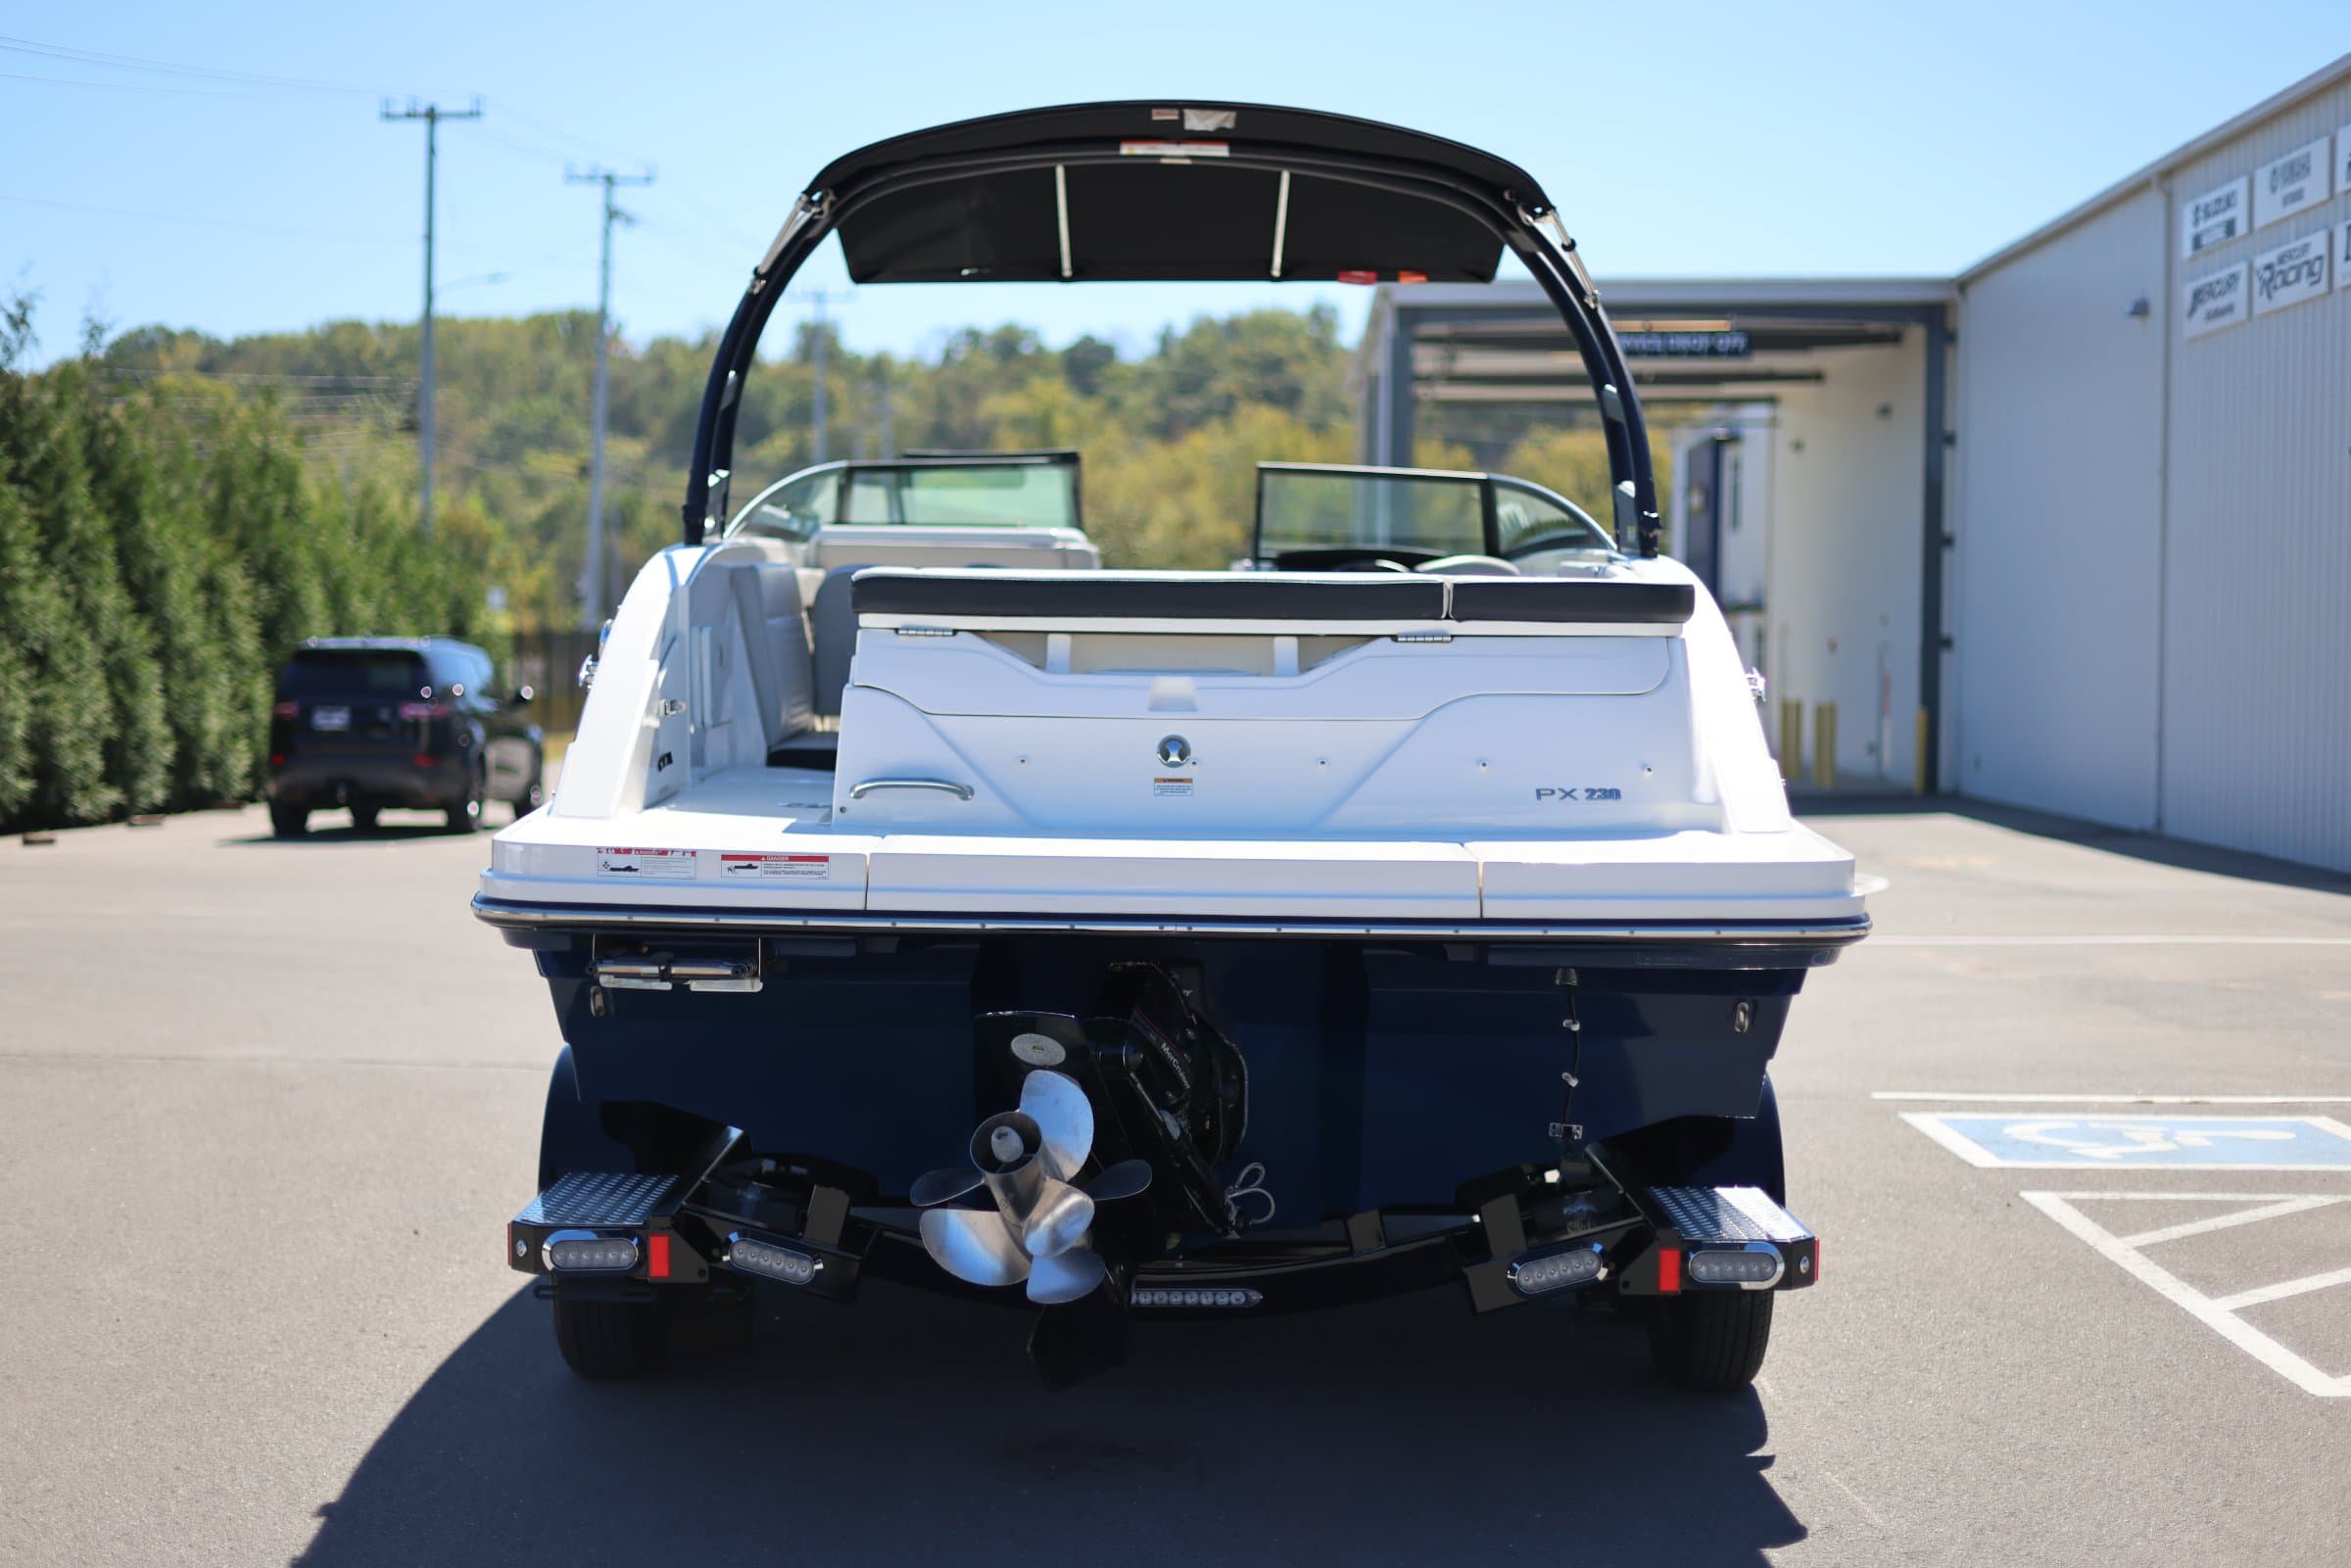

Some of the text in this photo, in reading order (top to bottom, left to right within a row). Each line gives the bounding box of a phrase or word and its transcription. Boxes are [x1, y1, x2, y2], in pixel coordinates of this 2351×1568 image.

[2257, 255, 2324, 301] Racing
[1535, 787, 1621, 800] PX 230
